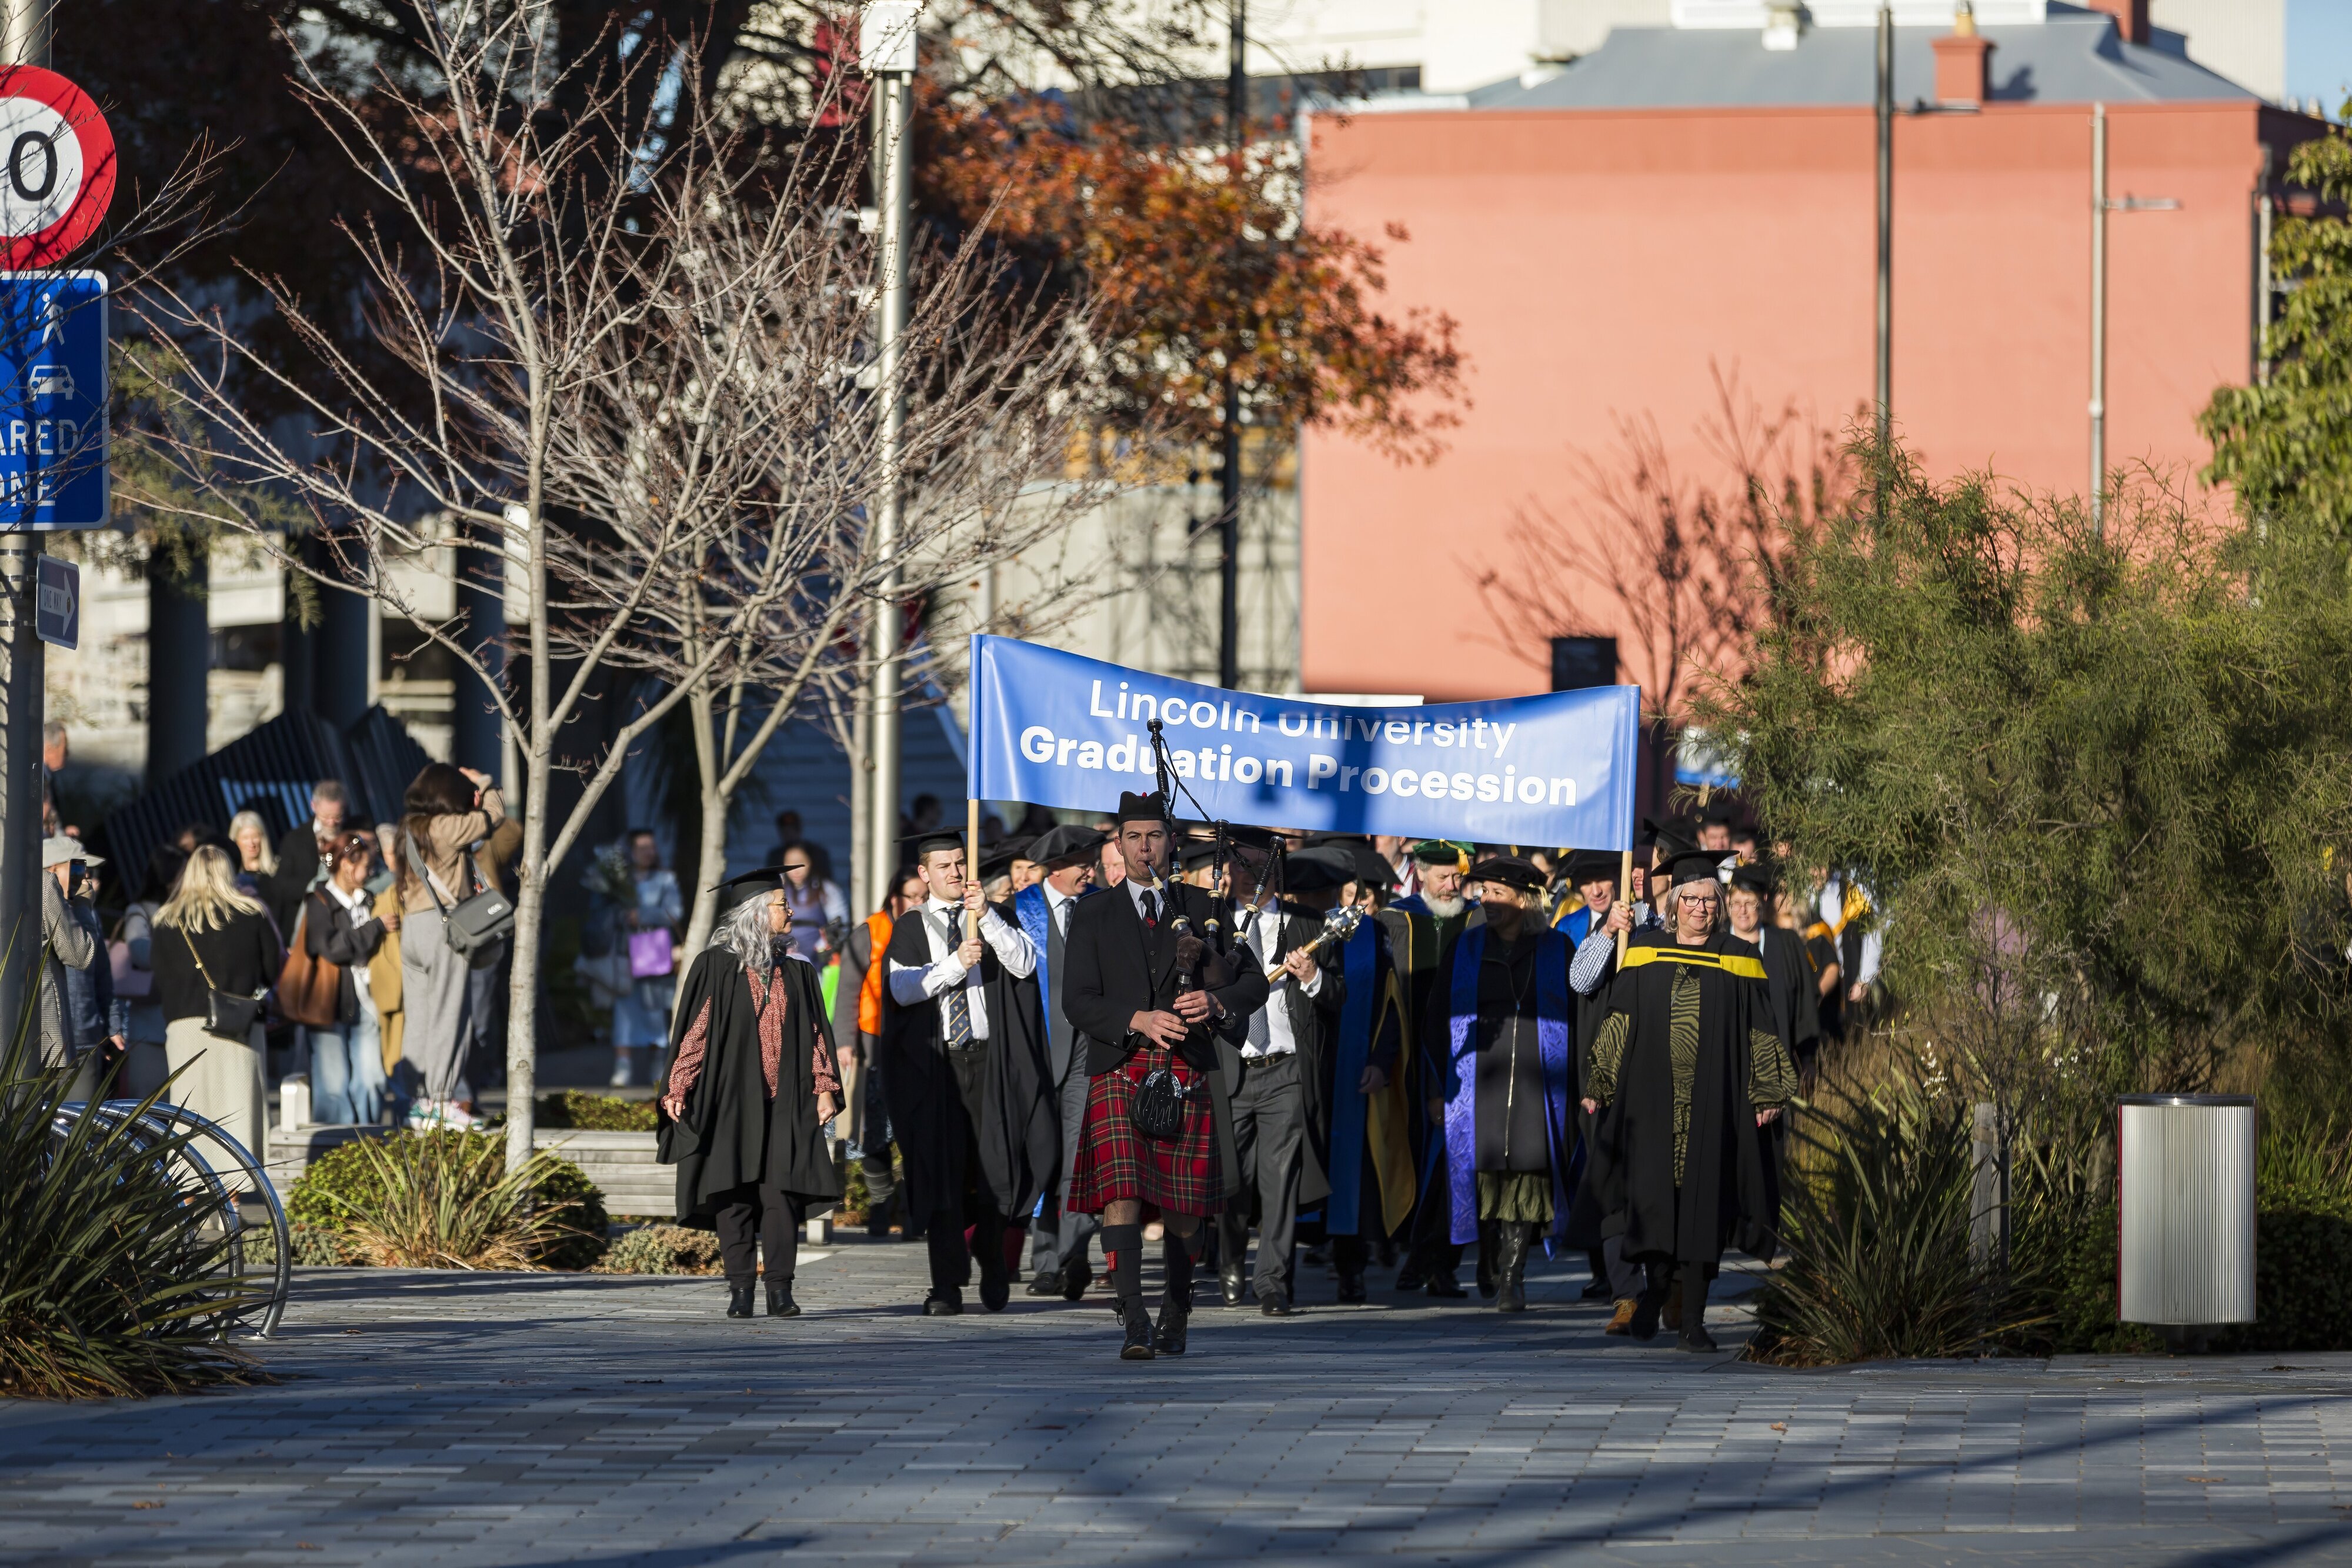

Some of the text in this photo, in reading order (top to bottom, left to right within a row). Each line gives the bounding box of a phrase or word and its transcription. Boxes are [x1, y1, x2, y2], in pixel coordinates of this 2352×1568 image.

[0, 419, 78, 456] RED
[0, 471, 55, 507] NE
[44, 590, 62, 612] ONE WAY
[1090, 679, 1517, 759] Lincoln University
[1020, 725, 1577, 806] Graduation Procession
